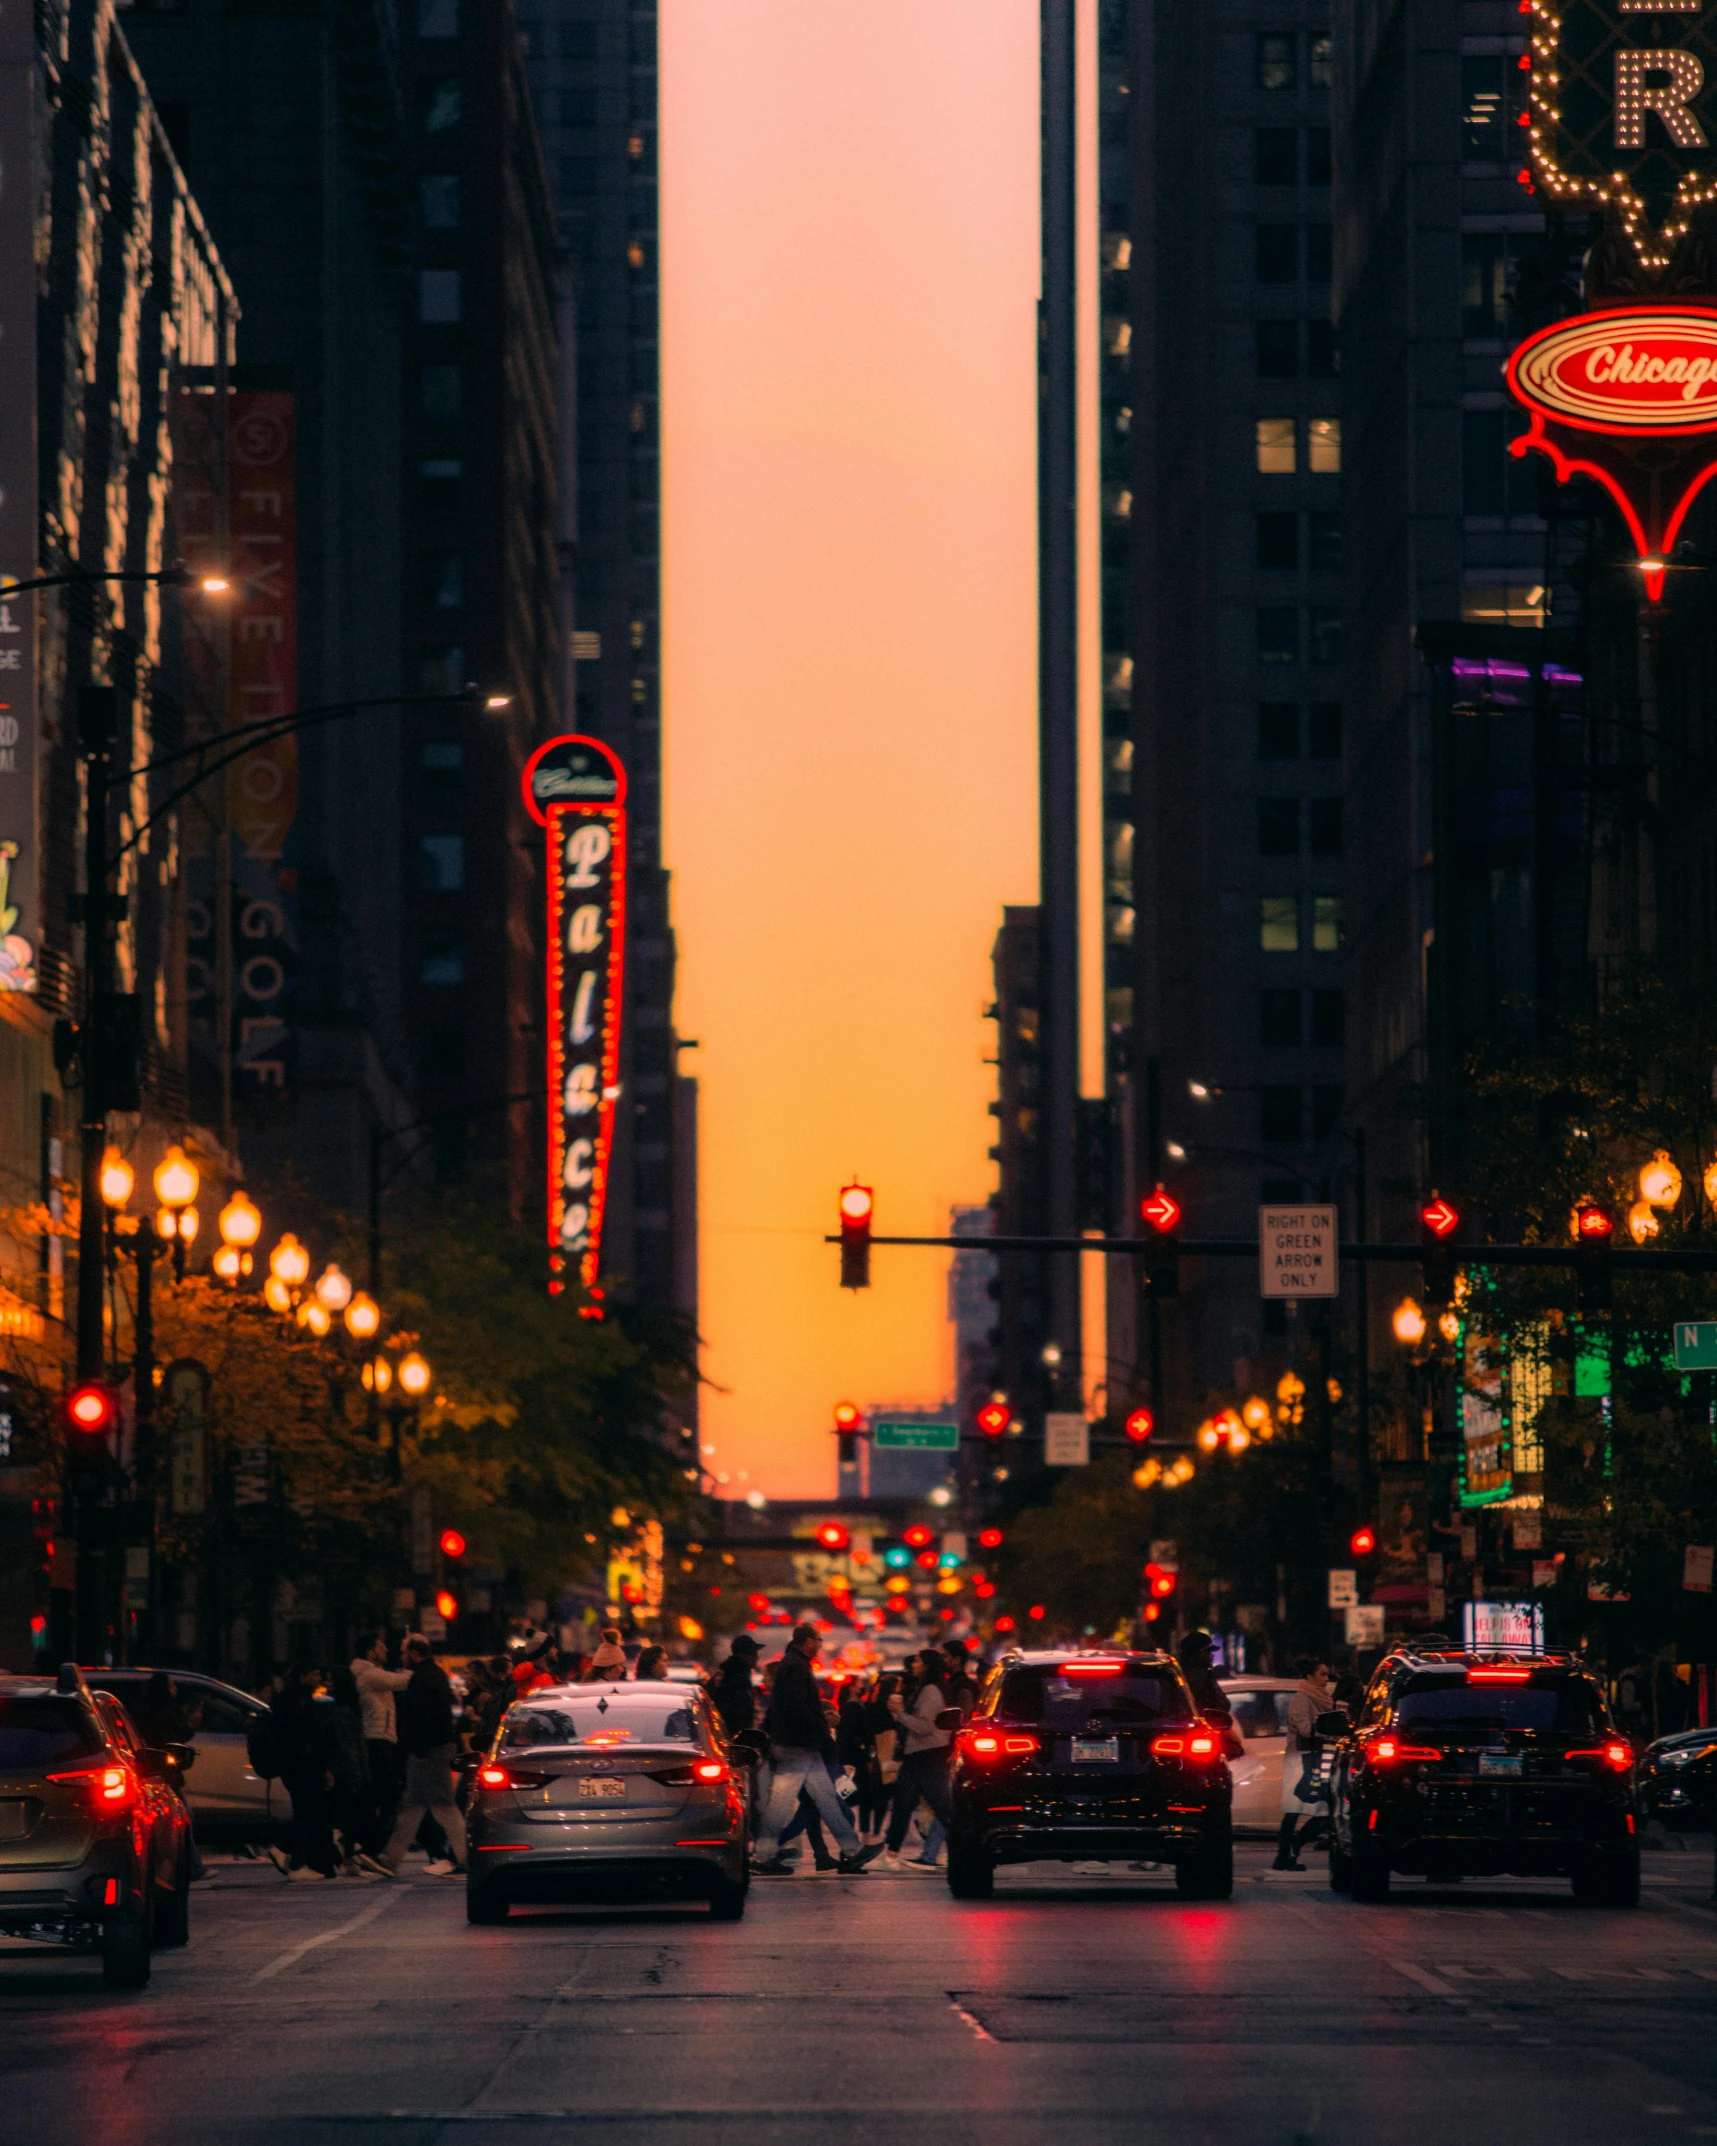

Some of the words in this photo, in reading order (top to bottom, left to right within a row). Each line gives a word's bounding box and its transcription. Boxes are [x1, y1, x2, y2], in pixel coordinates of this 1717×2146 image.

[1585, 343, 1717, 401] Chicag
[239, 491, 283, 643] FIVE
[240, 900, 286, 1088] GOLF
[564, 824, 612, 1252] Palace
[1267, 1215, 1305, 1229] RIGHT
[1311, 1215, 1329, 1229] ON
[1276, 1234, 1322, 1249] GREEN
[1275, 1253, 1322, 1268] ARROW
[1281, 1273, 1317, 1287] ONLY
[1684, 1325, 1698, 1348] N
